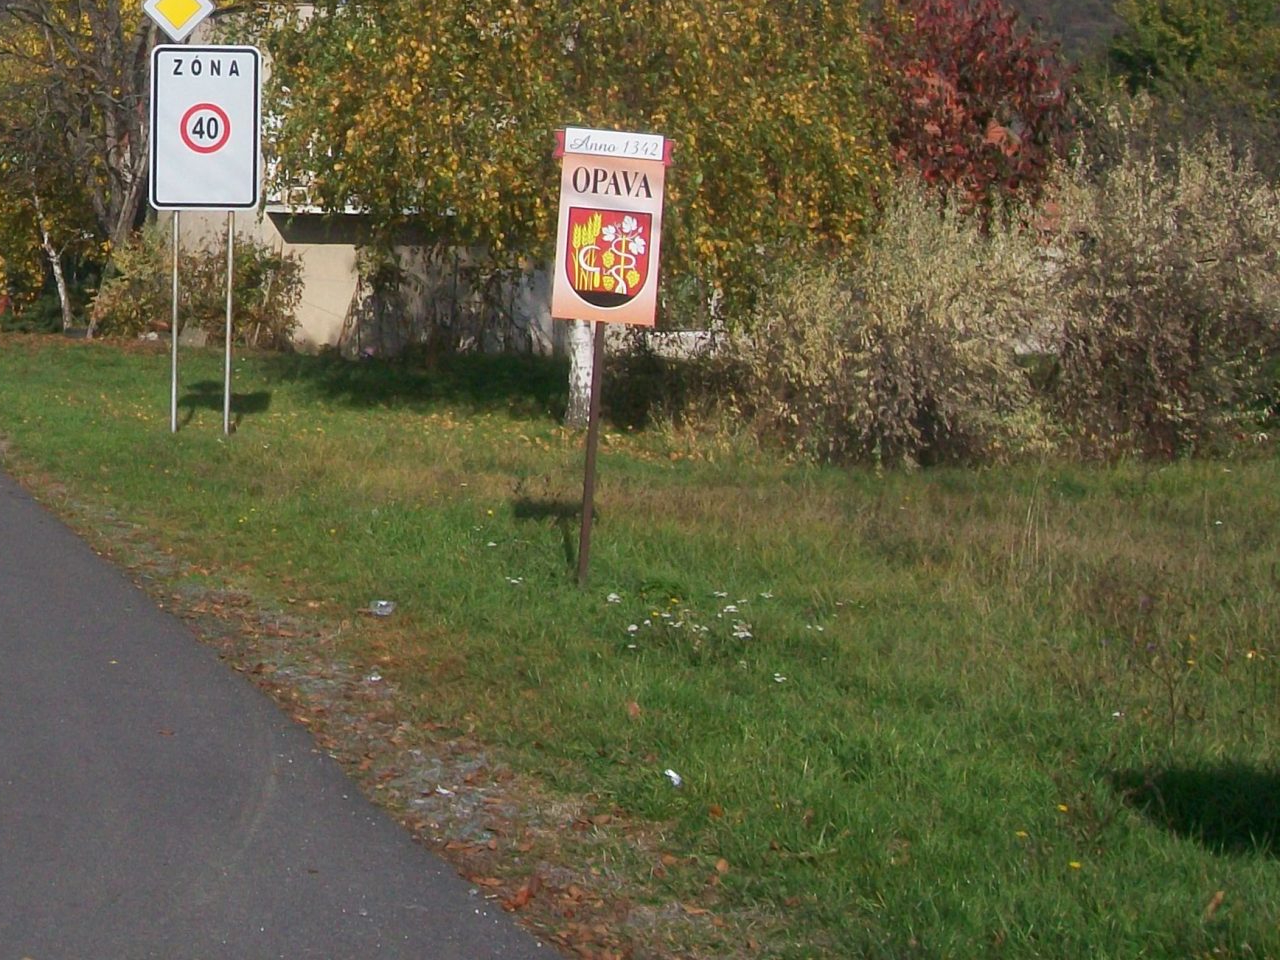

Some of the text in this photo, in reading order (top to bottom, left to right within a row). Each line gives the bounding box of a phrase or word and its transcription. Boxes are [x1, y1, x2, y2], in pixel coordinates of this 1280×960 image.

[173, 55, 240, 77] ZÓNA
[191, 116, 219, 140] 40
[570, 134, 659, 157] Anno 1342
[572, 166, 653, 199] OPAVA
